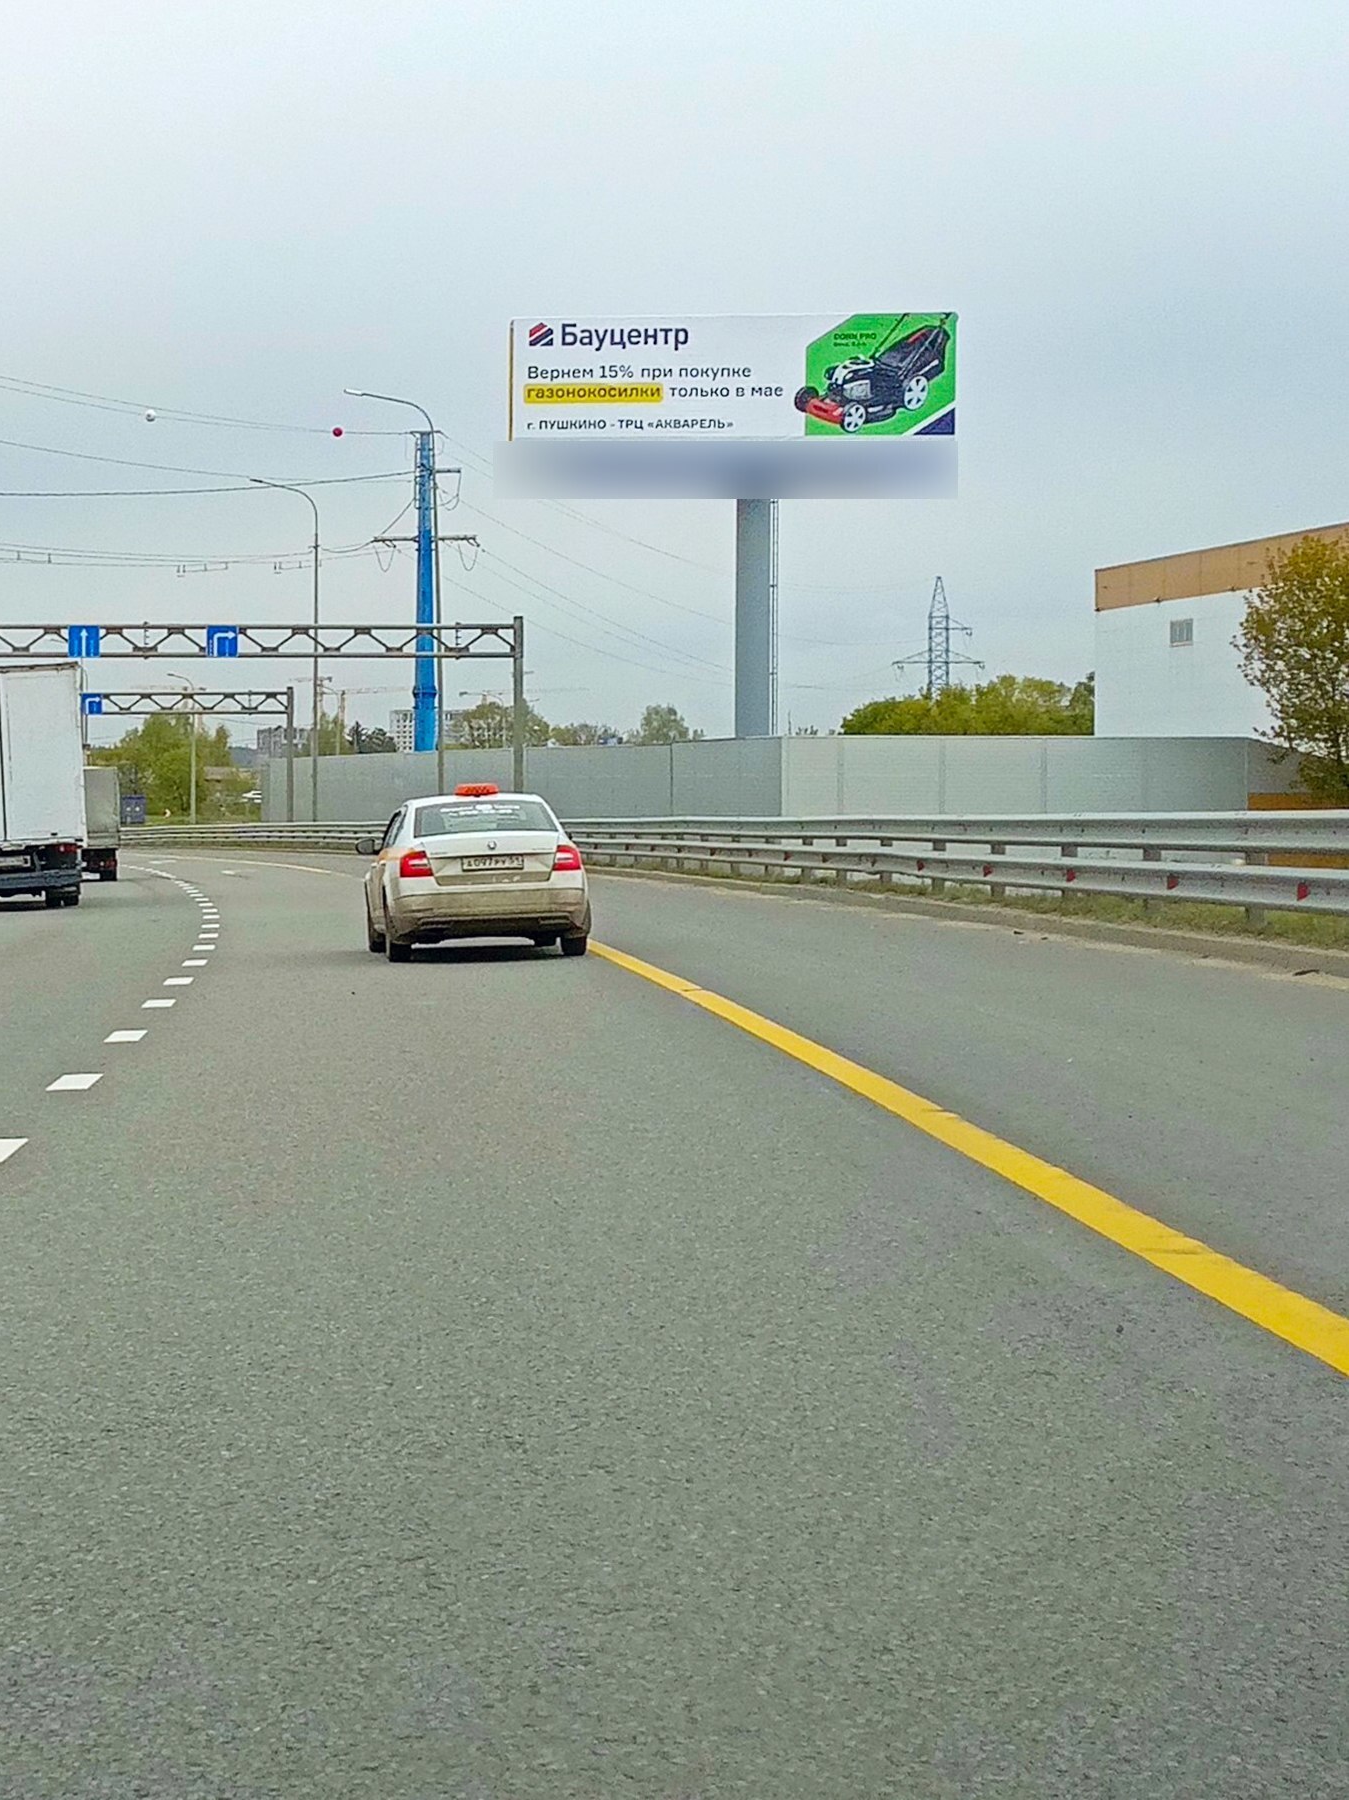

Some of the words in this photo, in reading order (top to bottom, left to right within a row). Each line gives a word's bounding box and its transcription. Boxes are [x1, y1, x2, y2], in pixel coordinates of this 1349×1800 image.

[561, 323, 689, 351] Бауцентр
[527, 366, 594, 381] Вернем
[599, 365, 634, 379] 15%
[641, 367, 673, 381] при
[679, 367, 752, 381] покупке
[526, 387, 661, 399] газонокосилки
[669, 386, 730, 397] только
[736, 386, 745, 397] в
[751, 386, 784, 397] мае
[539, 420, 607, 430] ПУШКИНО
[617, 420, 644, 431] ТРЦ
[647, 419, 734, 429] «АКВАРЕЛЬ»
